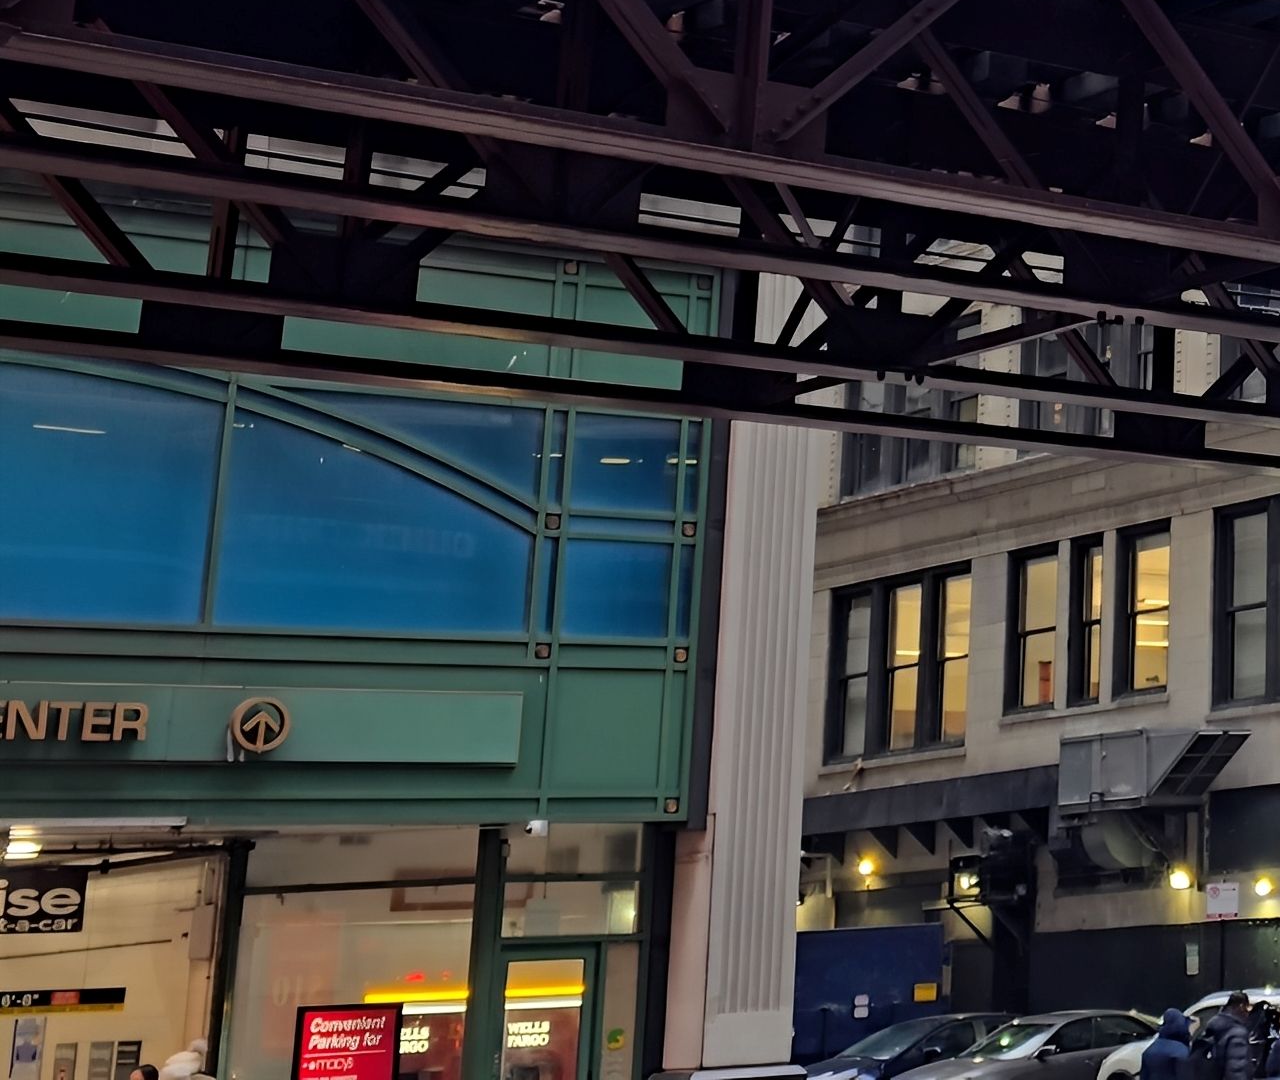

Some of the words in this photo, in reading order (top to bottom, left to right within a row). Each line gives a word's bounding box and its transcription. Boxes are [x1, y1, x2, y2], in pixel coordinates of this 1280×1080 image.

[310, 1016, 386, 1033] Convenient
[507, 1020, 551, 1035] WELLS
[307, 1033, 361, 1051] Parking
[362, 1031, 382, 1047] for
[507, 1033, 550, 1048] FARGO
